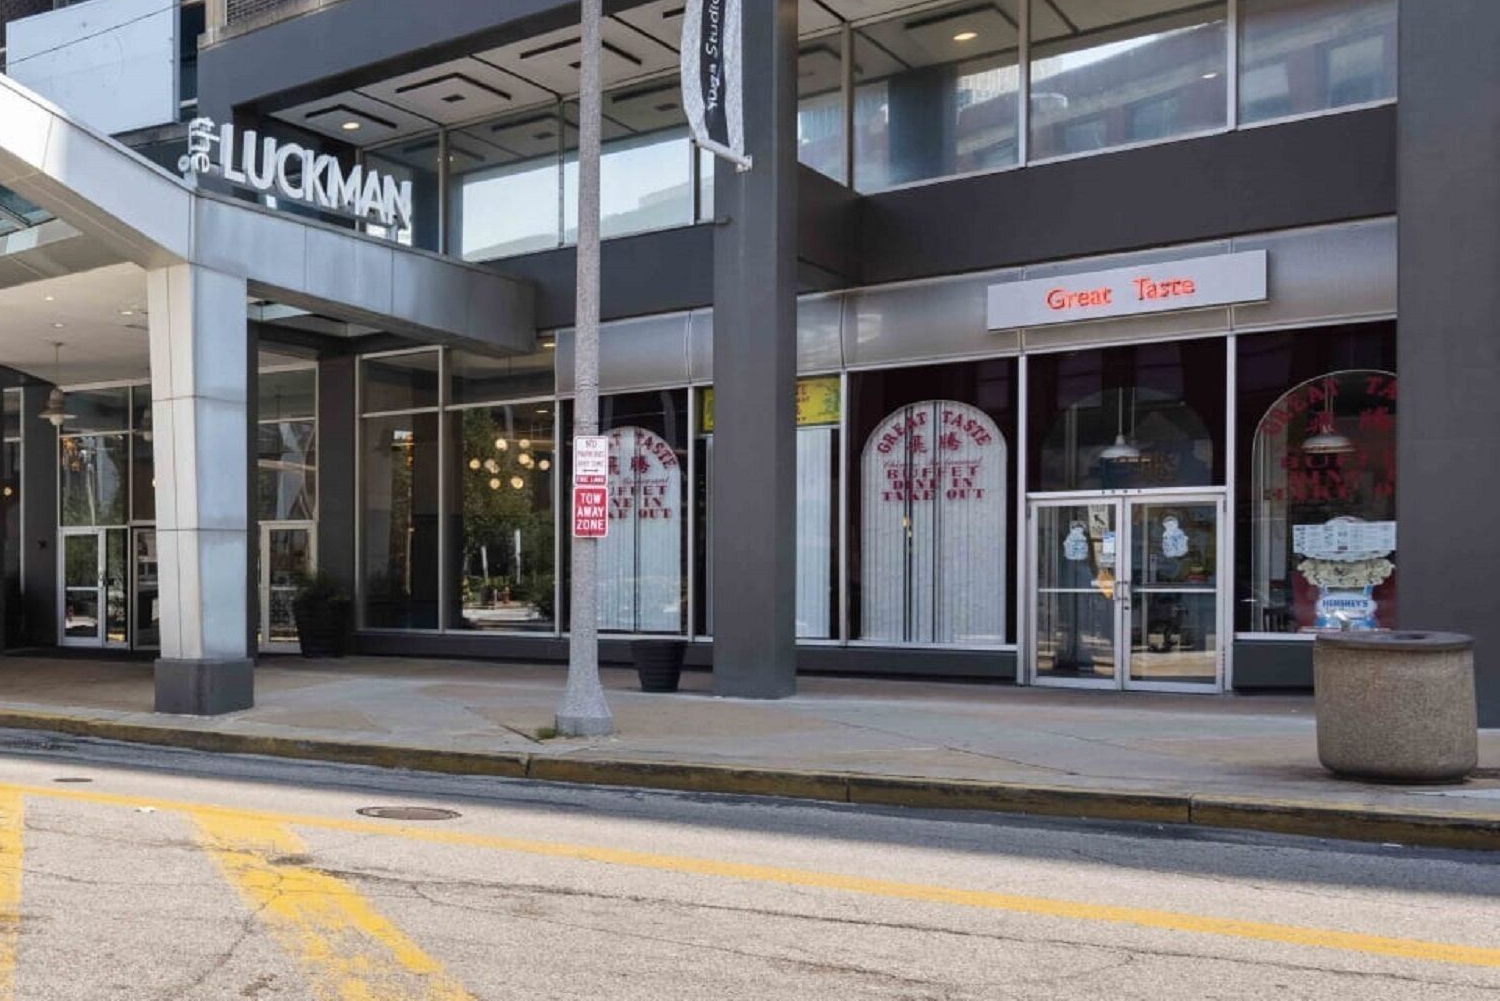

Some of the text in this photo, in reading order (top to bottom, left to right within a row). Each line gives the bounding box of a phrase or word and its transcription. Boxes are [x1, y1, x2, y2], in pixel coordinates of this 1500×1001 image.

[220, 122, 412, 232] LUCKMAN
[1047, 276, 1196, 310] Great Taste
[877, 410, 992, 454] GREAT TASTE
[887, 465, 979, 479] BUFFET
[952, 477, 973, 488] IN
[580, 493, 602, 504] TOW
[882, 488, 985, 501] TAKE OUT
[576, 507, 604, 517] AWAY
[638, 508, 671, 519] OUT
[576, 520, 605, 530] ZONE
